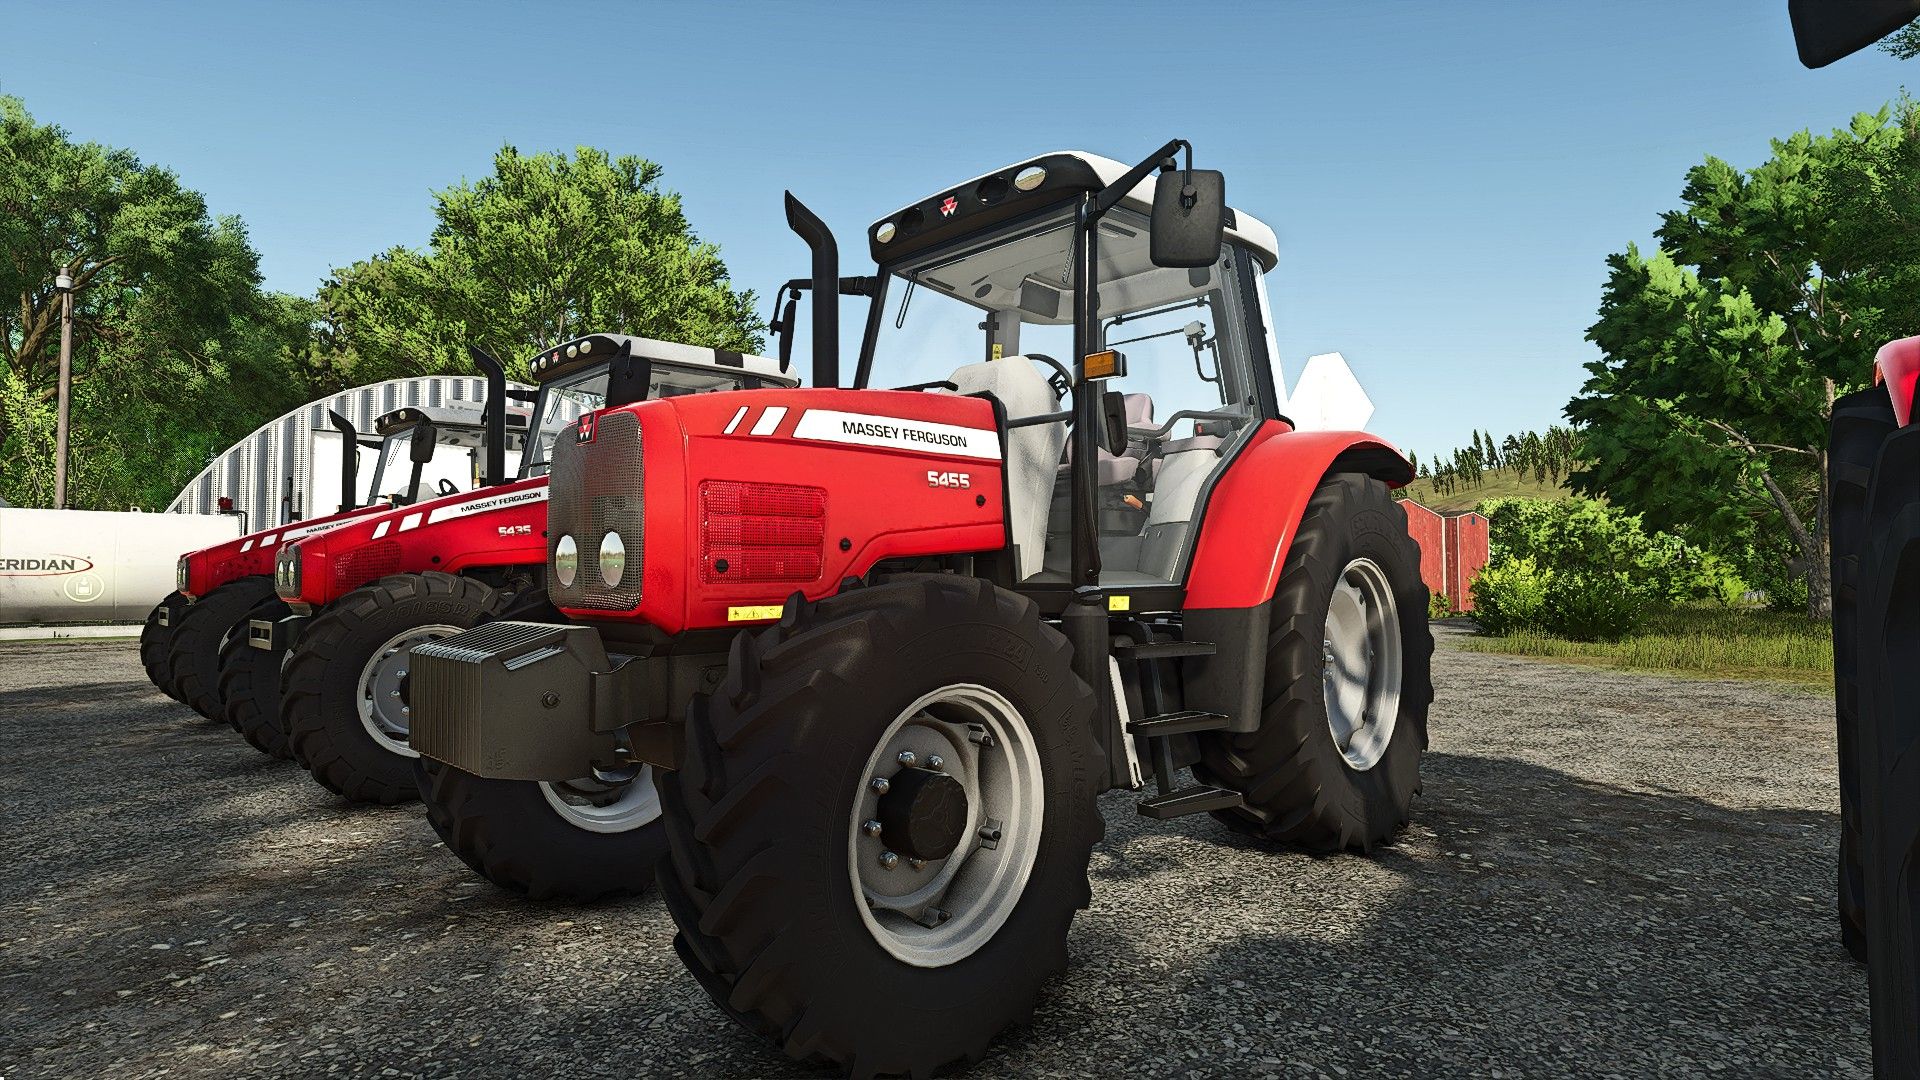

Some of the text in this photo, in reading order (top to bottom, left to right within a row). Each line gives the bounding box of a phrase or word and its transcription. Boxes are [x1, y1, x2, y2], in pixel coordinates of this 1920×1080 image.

[842, 421, 968, 448] MASSEY FERGUSON
[927, 470, 970, 489] 5455
[461, 491, 542, 513] MASSEY FERGUSON
[498, 524, 532, 537] 5435
